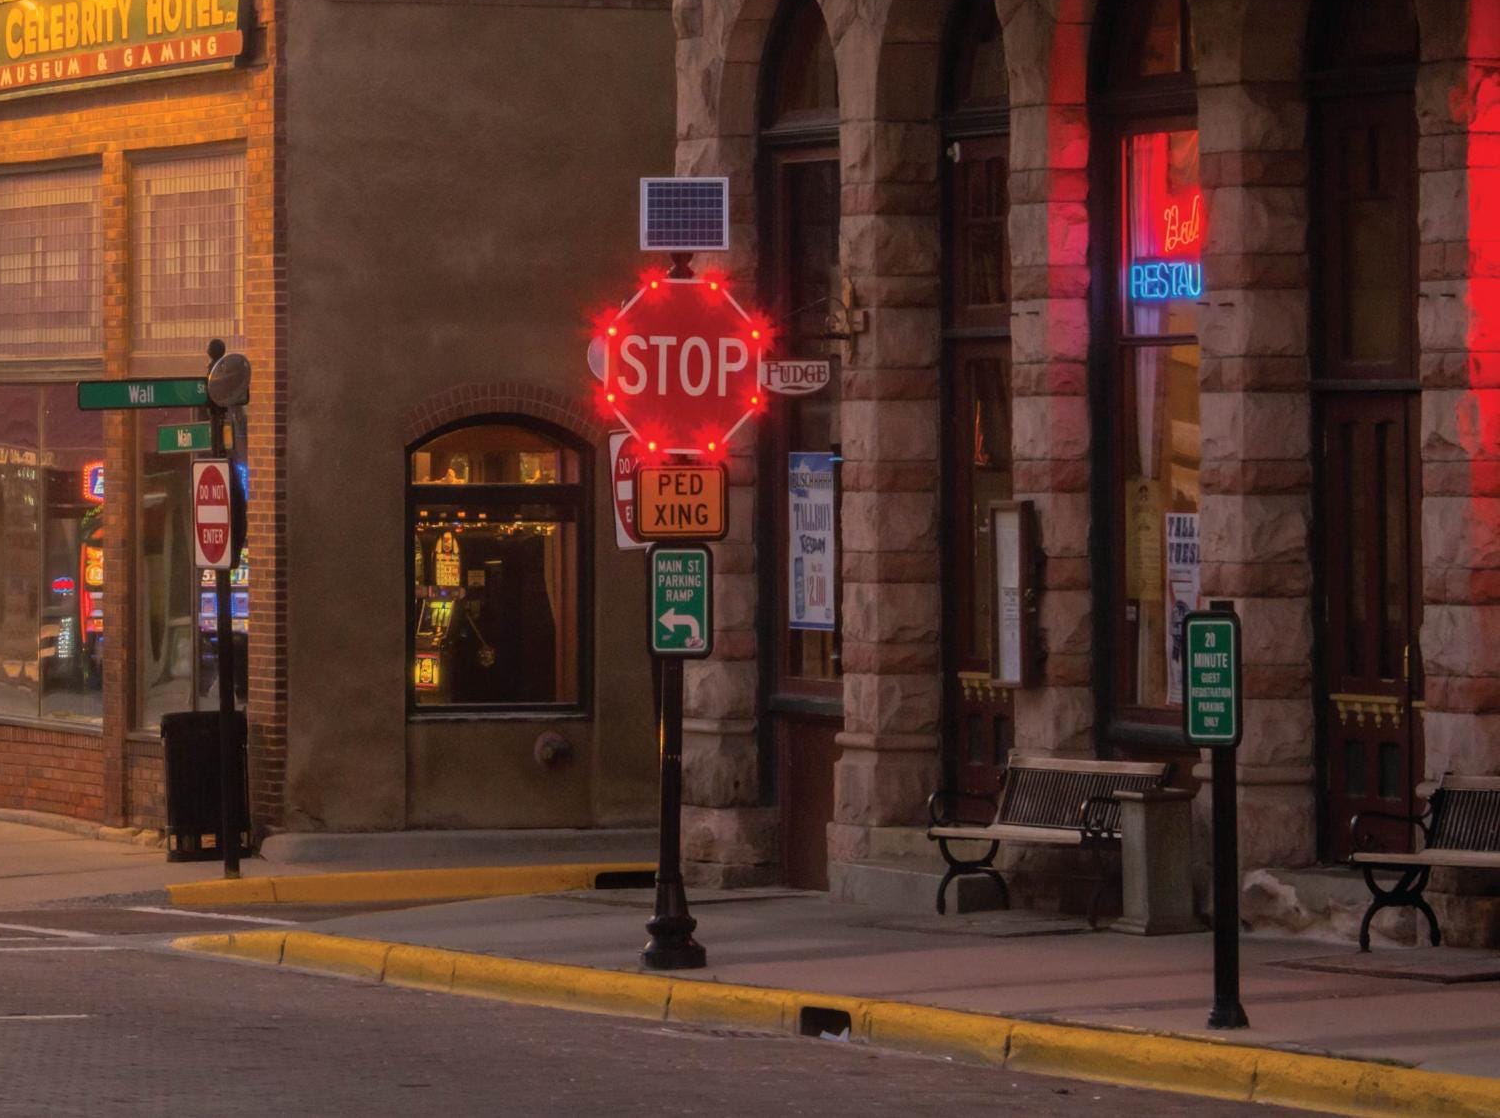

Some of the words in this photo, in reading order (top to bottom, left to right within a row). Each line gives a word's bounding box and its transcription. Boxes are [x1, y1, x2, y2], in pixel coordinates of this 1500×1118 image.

[0, 58, 80, 86] MUSEUM
[97, 52, 108, 71] &
[123, 36, 217, 65] GAMING
[1131, 262, 1201, 299] RESTAU
[617, 334, 749, 397] STOP
[766, 362, 828, 385] FUDGE
[128, 385, 154, 404] Wall
[177, 429, 193, 447] Main
[658, 472, 703, 495] PED
[200, 487, 209, 500] DO
[212, 485, 225, 499] NOT
[655, 503, 708, 526] XING
[203, 529, 224, 544] ENTER
[658, 560, 682, 572] MAIN
[658, 574, 701, 587] PARKING
[666, 589, 694, 602] RAMP
[1204, 632, 1216, 648] 20
[1194, 652, 1228, 668] MINUTE
[1198, 702, 1225, 713] PARKING
